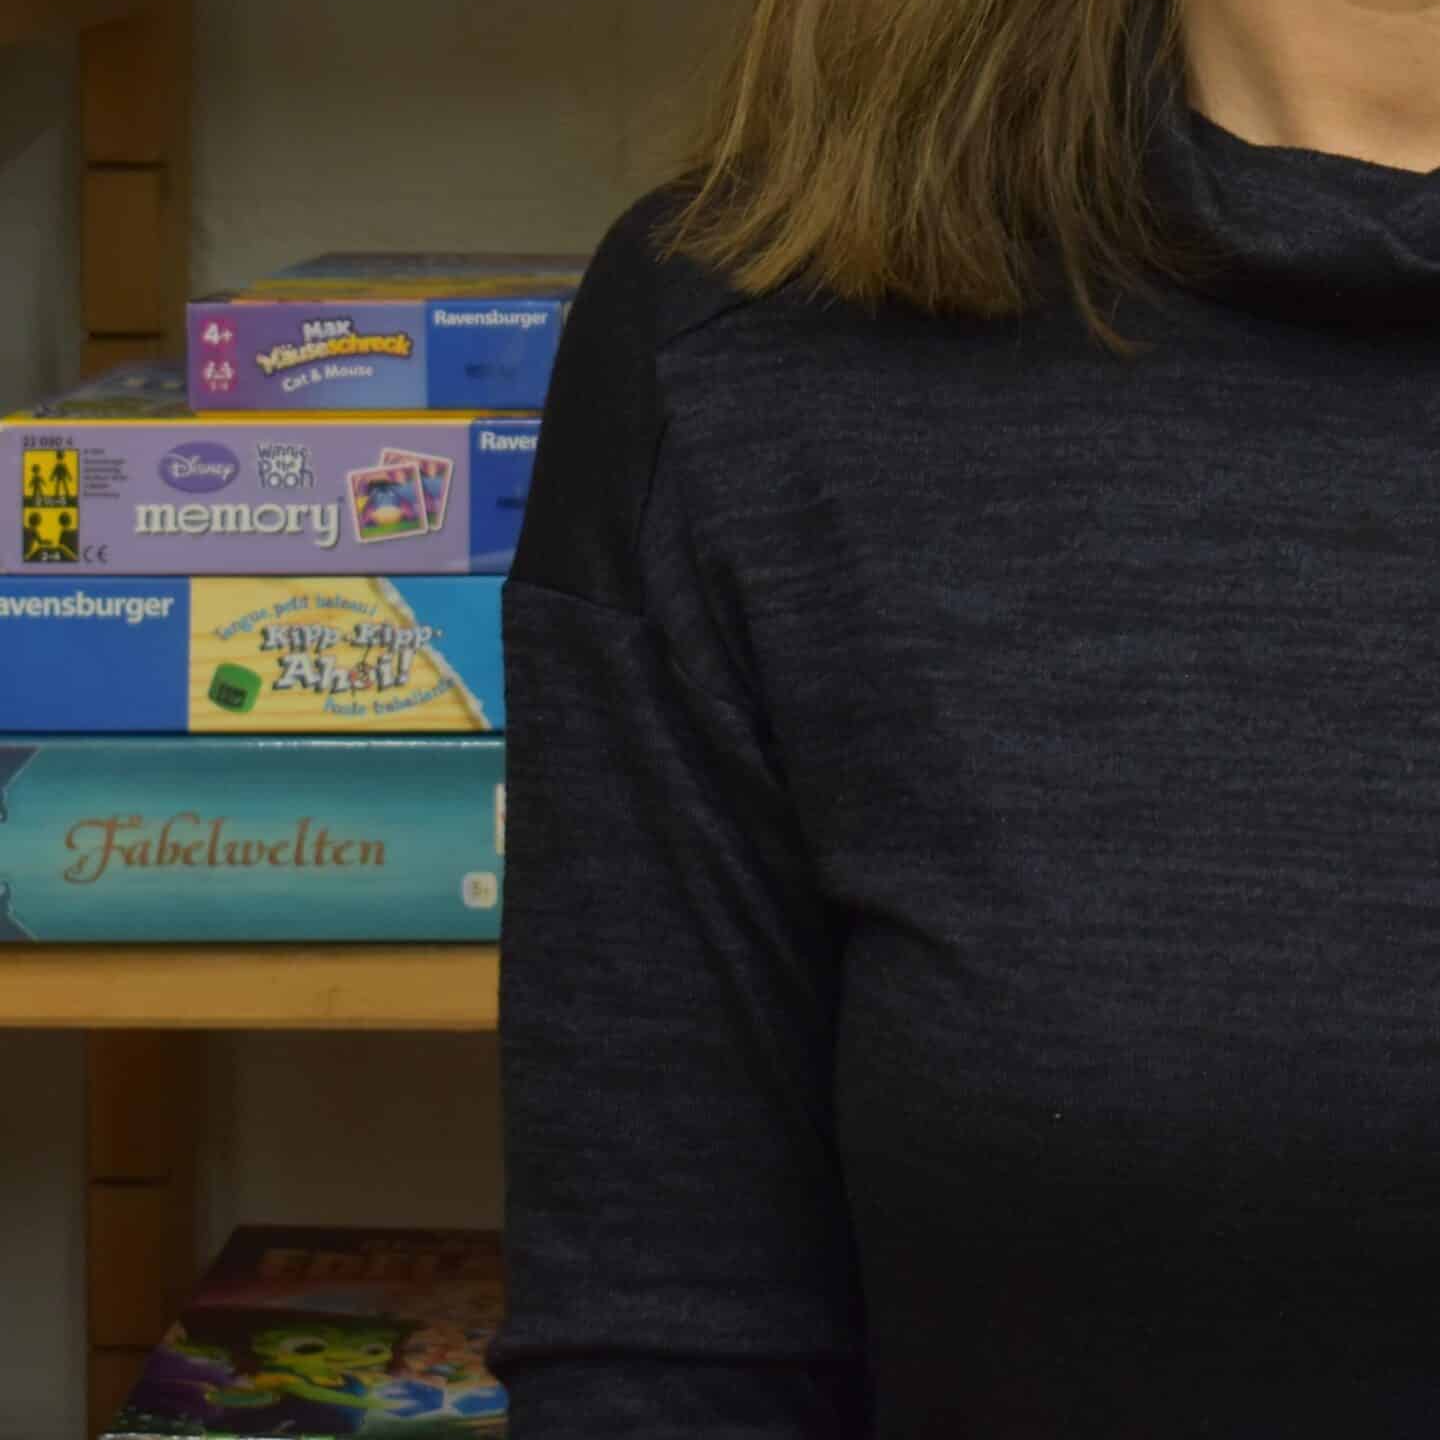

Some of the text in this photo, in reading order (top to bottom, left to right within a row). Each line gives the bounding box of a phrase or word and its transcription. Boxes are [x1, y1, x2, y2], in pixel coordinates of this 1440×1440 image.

[203, 323, 233, 344] 4+
[303, 320, 352, 341] Max
[434, 309, 548, 329] Ravensburger
[281, 371, 311, 392] Cat
[325, 362, 374, 379] Mouse
[168, 452, 235, 482] Disney
[258, 458, 313, 489] Pooh
[134, 503, 341, 548] memory
[274, 649, 416, 693] Ahoi!
[62, 811, 387, 886] Fabelwelten
